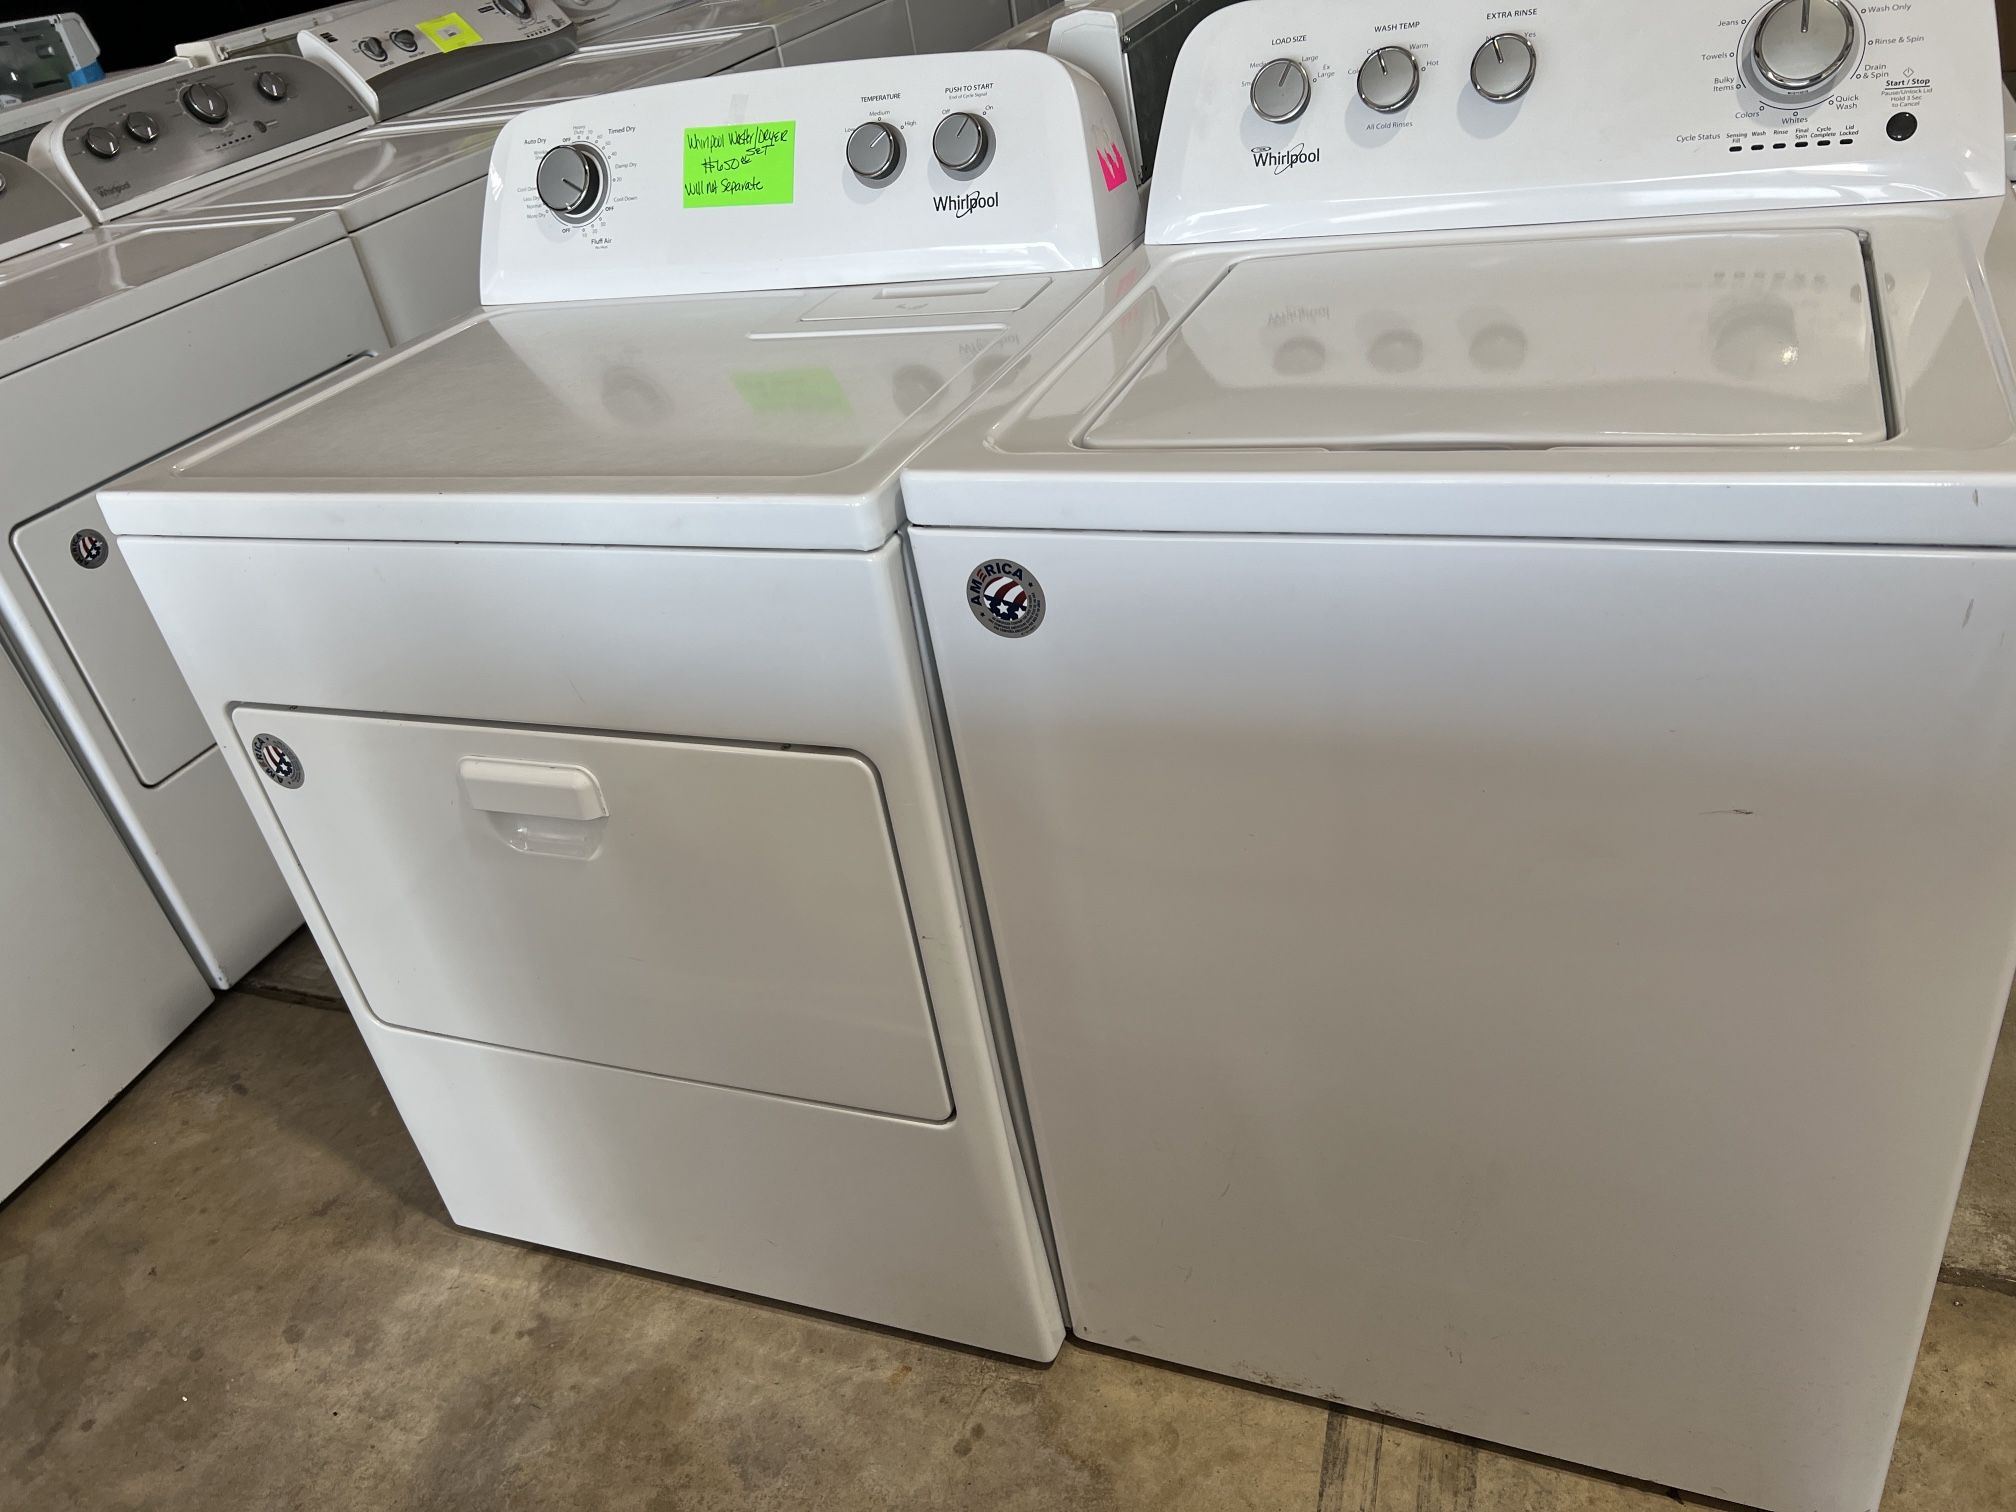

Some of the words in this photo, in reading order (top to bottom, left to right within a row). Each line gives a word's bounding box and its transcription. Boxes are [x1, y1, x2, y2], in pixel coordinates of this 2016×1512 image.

[1868, 5, 1890, 13] Wash
[1487, 11, 1512, 20] EXTRA
[1515, 8, 1537, 17] RINSE
[1374, 24, 1397, 33] WASH
[1399, 21, 1420, 30] TEMP
[1718, 19, 1738, 27] Jeans
[1272, 37, 1291, 46] LOAD
[1293, 35, 1307, 43] SIZE
[1875, 37, 1896, 45] Rinse
[1906, 35, 1924, 44] Spin
[1702, 52, 1727, 61] Towels
[1426, 59, 1439, 67] Hot
[1864, 63, 1887, 71] Drain
[1871, 71, 1889, 80] Spin
[1715, 77, 1734, 85] Bulky
[1912, 78, 1930, 86] Stop
[945, 86, 962, 94] PUSH
[973, 83, 994, 91] START
[1713, 84, 1734, 92] Items
[861, 93, 901, 103] TEMPERATURE
[1835, 95, 1859, 103] Quick
[1735, 111, 1760, 119] Colors
[1781, 116, 1808, 125] Whites
[1676, 135, 1696, 143] Cycle
[1697, 133, 1721, 141] Status
[1810, 131, 1836, 139] Complete
[746, 144, 775, 156] SET
[1253, 145, 1320, 172] Whirlpool
[721, 176, 764, 195] Separate
[933, 191, 998, 217] Whirlpool
[970, 563, 1023, 606] AMERICA
